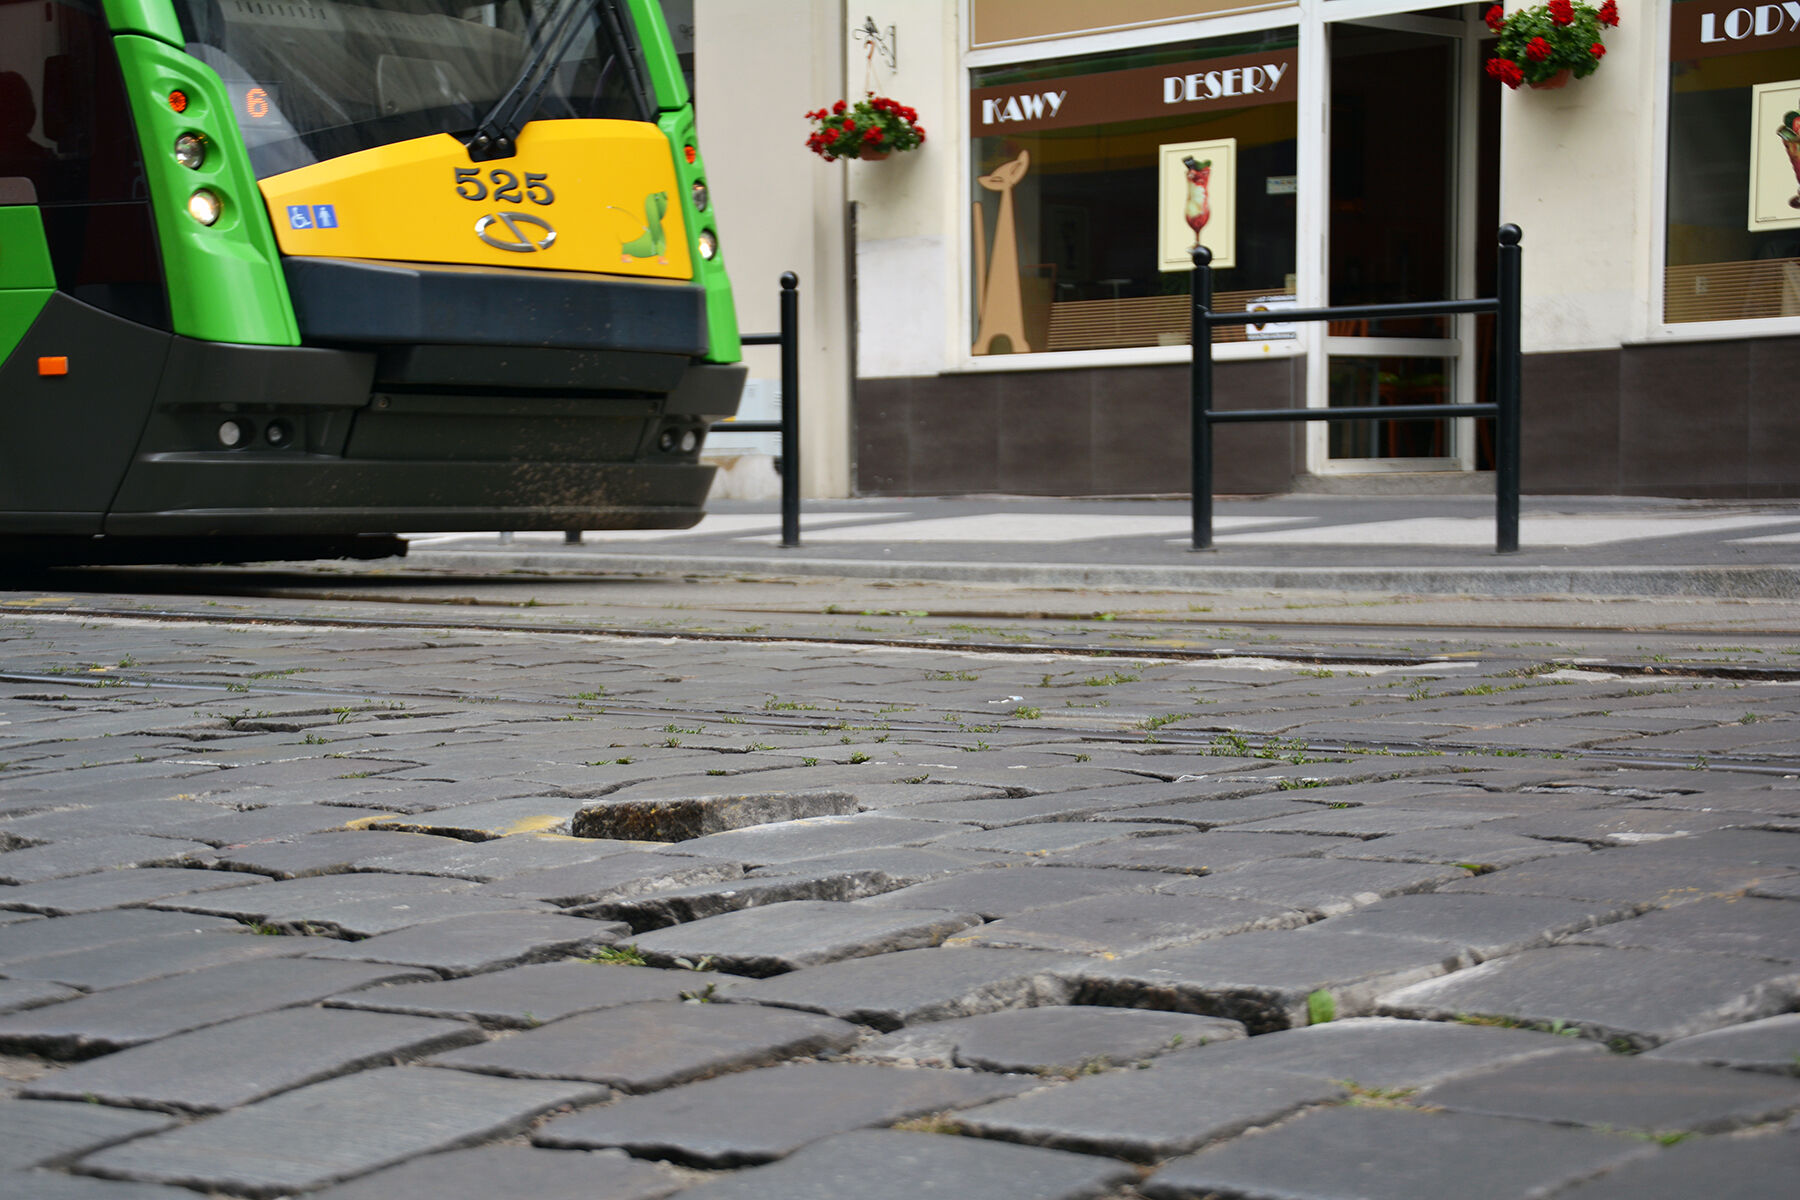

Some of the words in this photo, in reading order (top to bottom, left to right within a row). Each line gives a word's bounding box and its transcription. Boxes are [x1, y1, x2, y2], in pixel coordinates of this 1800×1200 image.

[1701, 1, 1800, 43] LODY
[1163, 62, 1288, 104] DESERY
[246, 88, 269, 118] 6
[983, 90, 1067, 124] KAWY
[454, 167, 555, 205] 525
